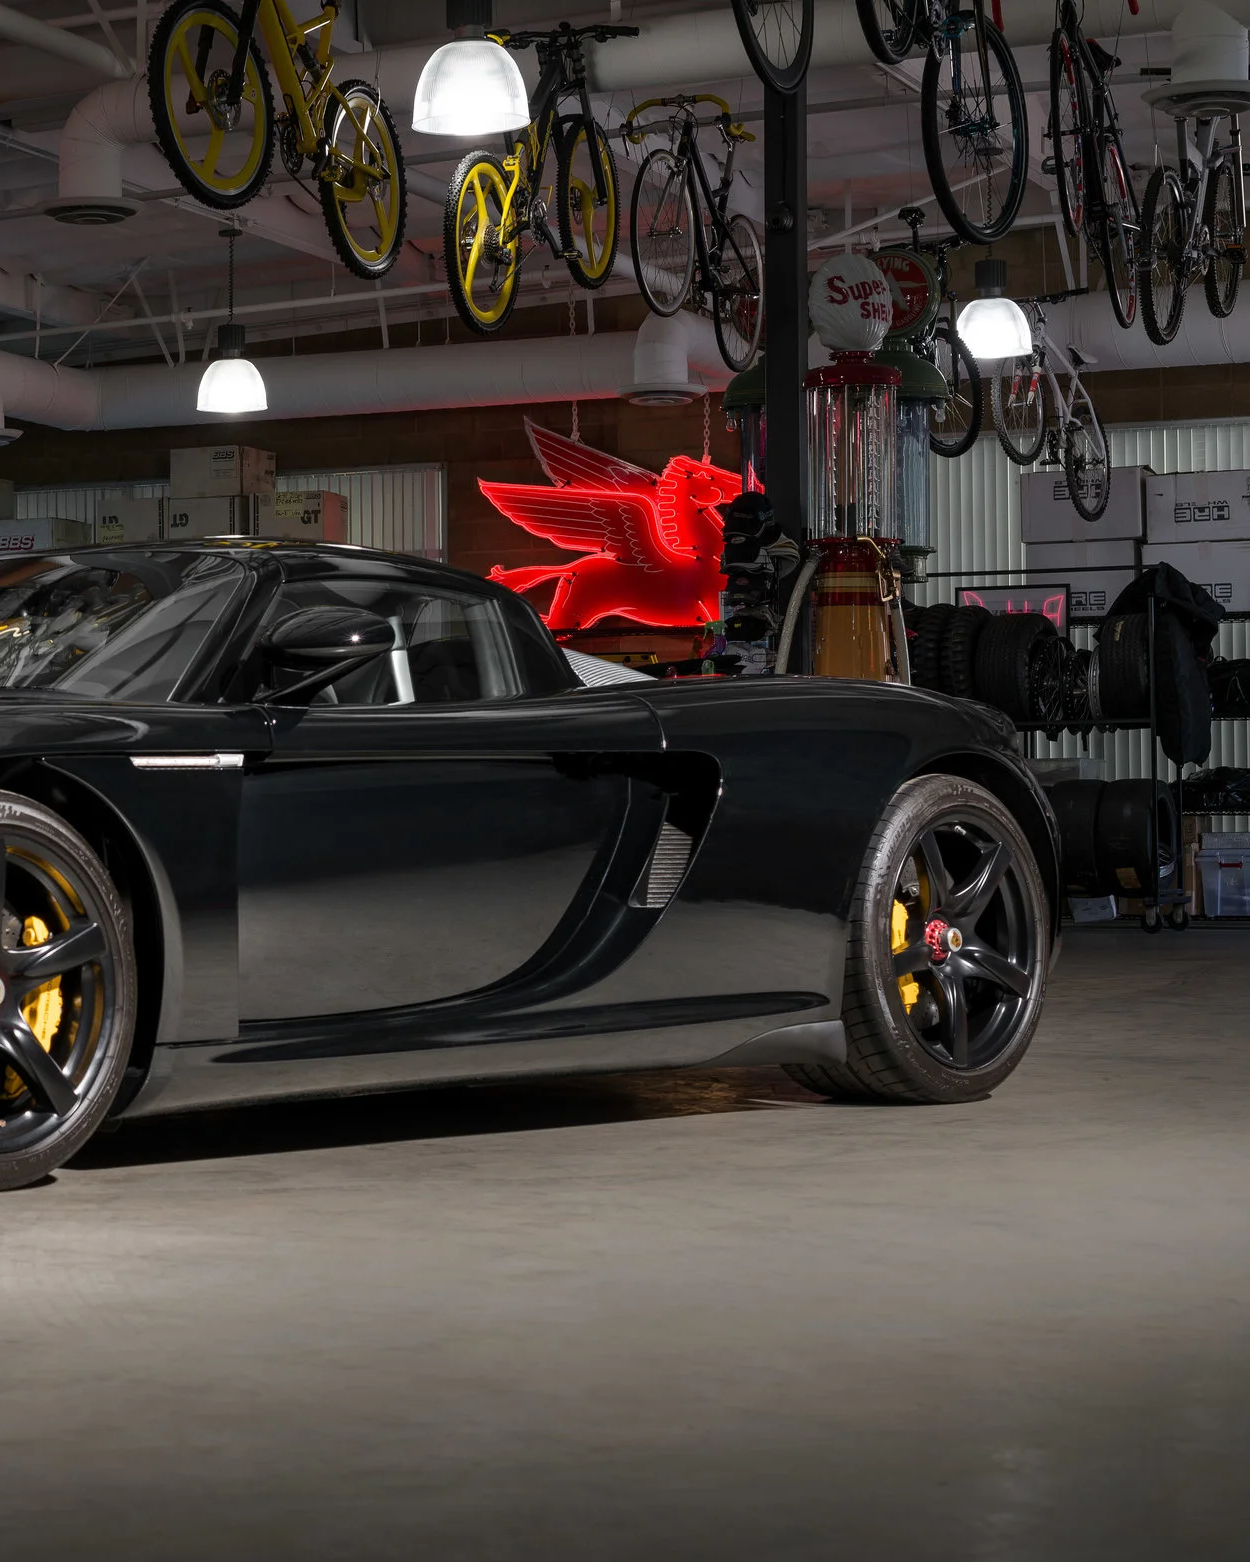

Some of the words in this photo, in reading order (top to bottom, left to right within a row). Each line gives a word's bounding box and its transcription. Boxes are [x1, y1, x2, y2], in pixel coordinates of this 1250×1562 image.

[860, 301, 891, 322] SHE
[212, 450, 235, 460] BBS
[171, 512, 189, 528] GT
[301, 509, 321, 524] GT
[1174, 505, 1230, 523] HRE
[1070, 591, 1106, 606] RE
